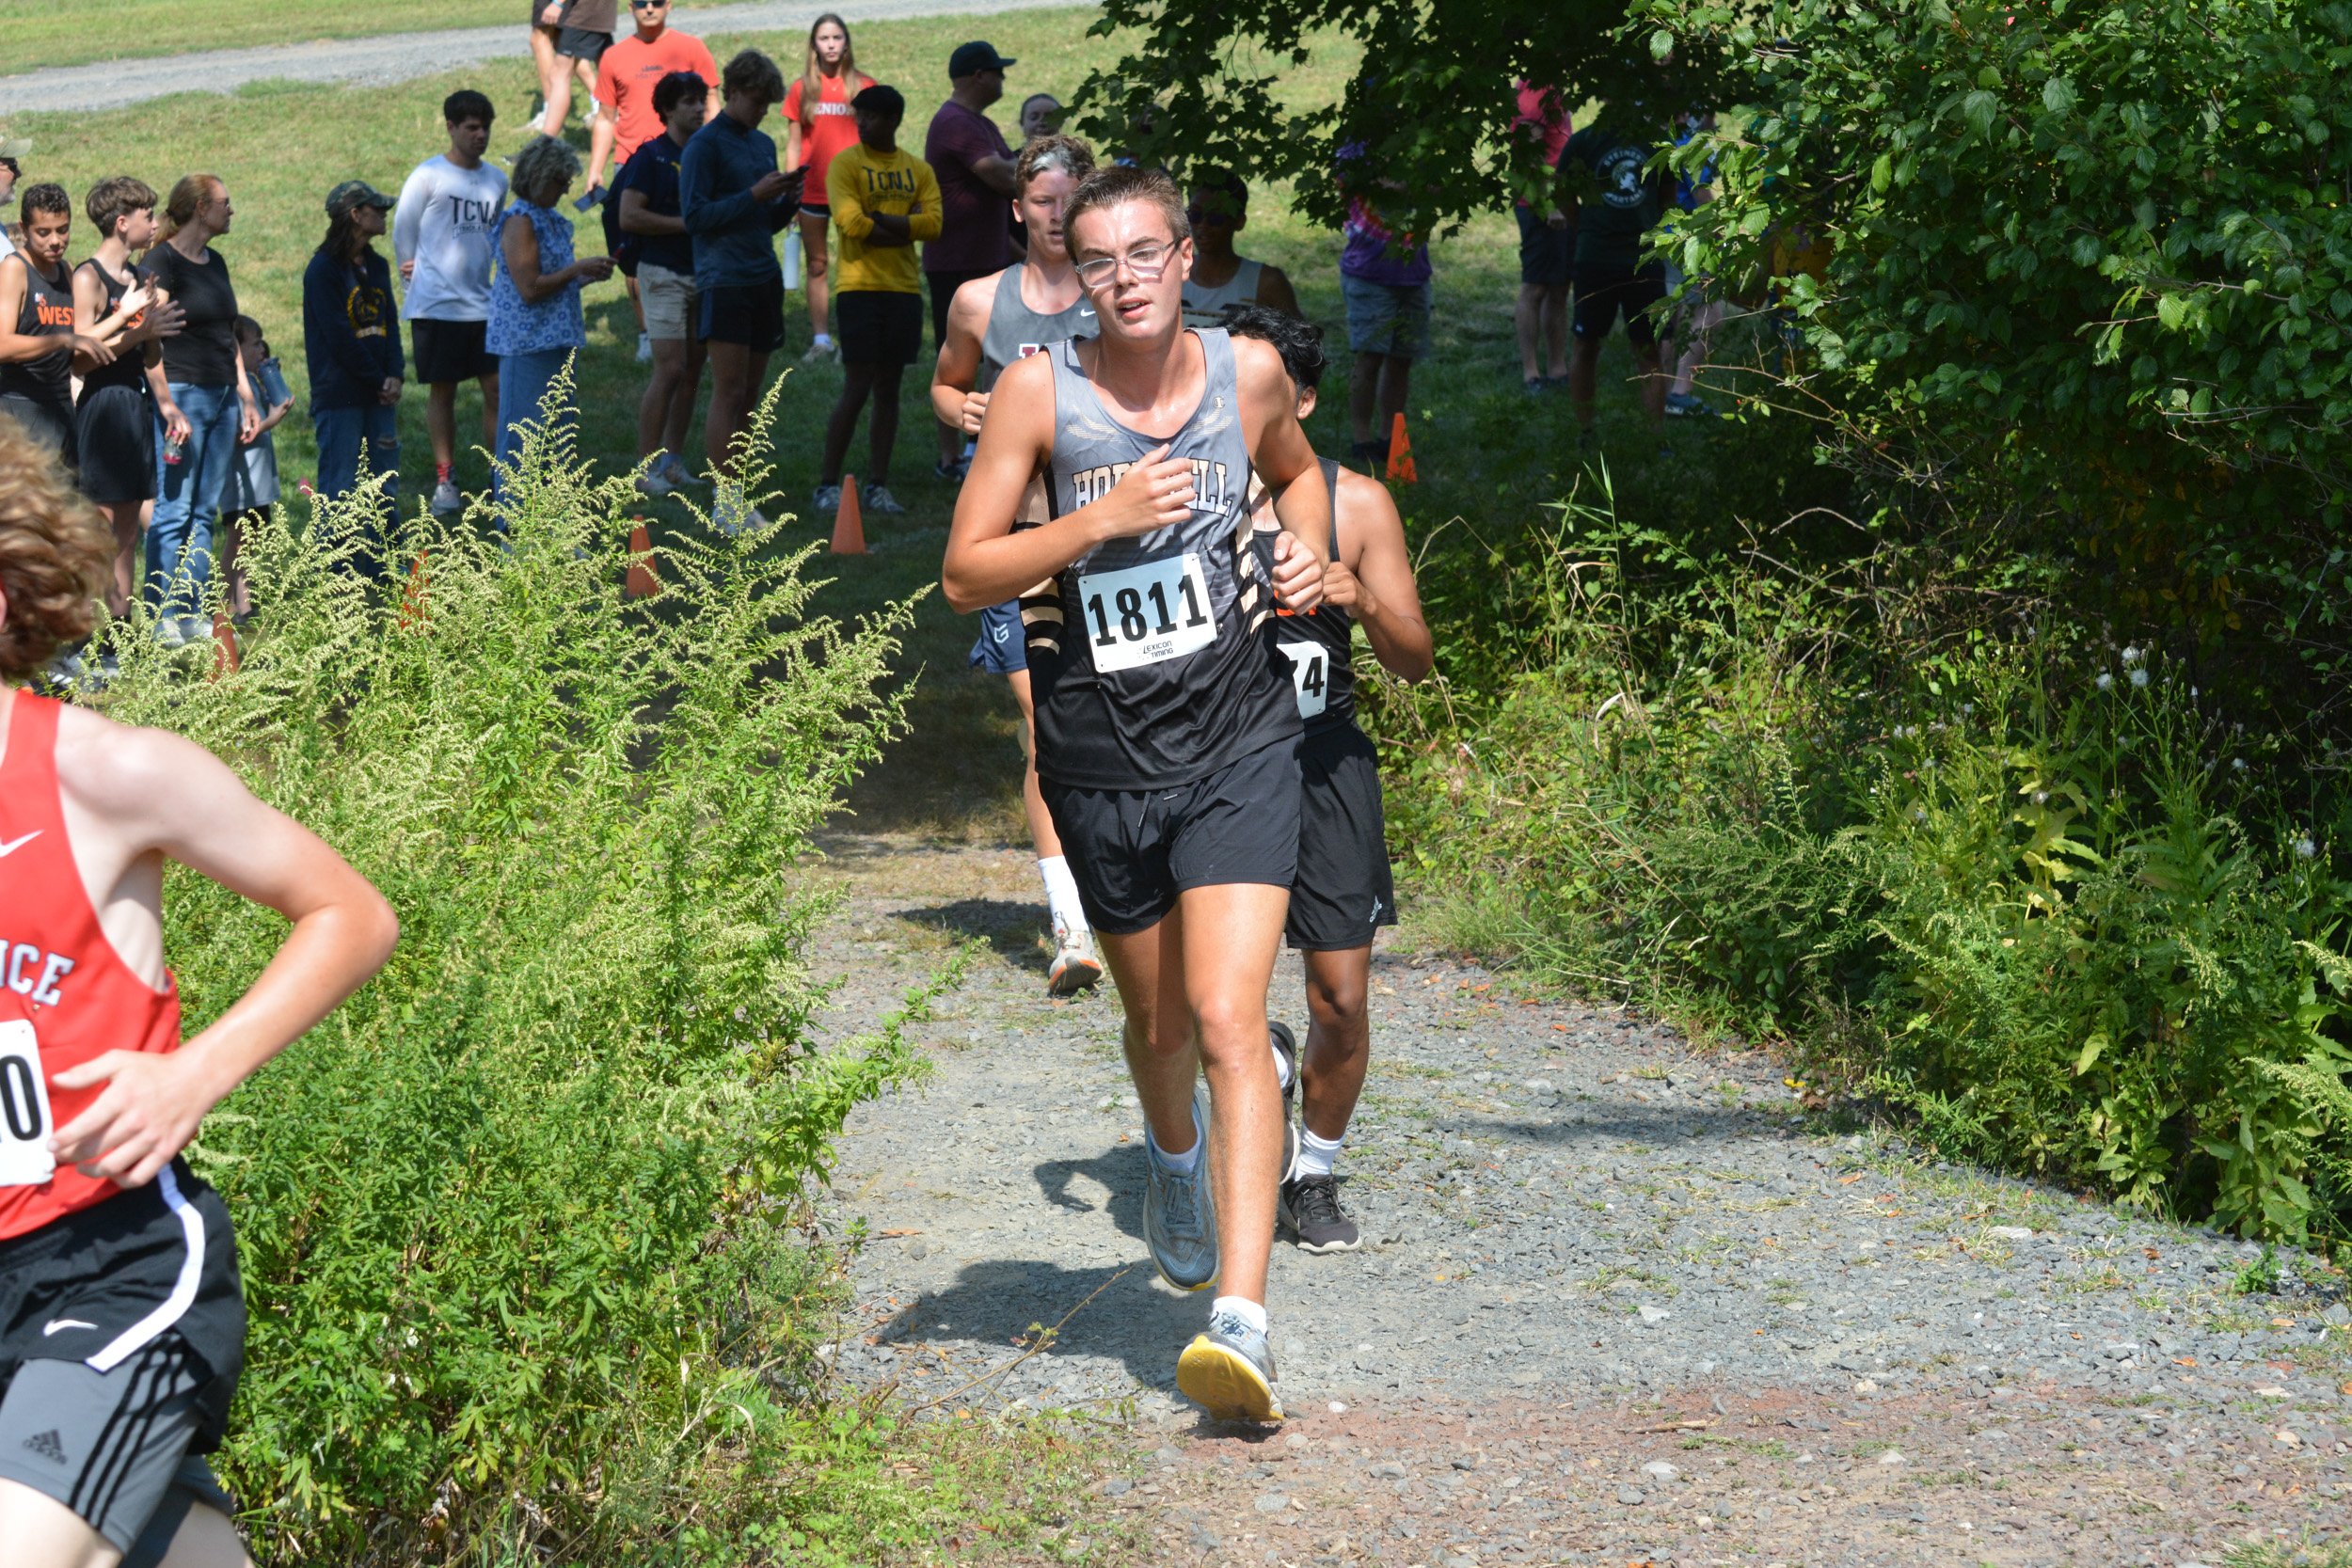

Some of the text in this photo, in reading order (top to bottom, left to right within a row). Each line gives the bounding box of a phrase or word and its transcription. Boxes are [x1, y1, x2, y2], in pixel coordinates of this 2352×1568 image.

[862, 166, 915, 194] TCNJ
[1088, 574, 1207, 647] 1811
[1143, 641, 1172, 655] LEXICON
[1151, 648, 1174, 658] TIMING
